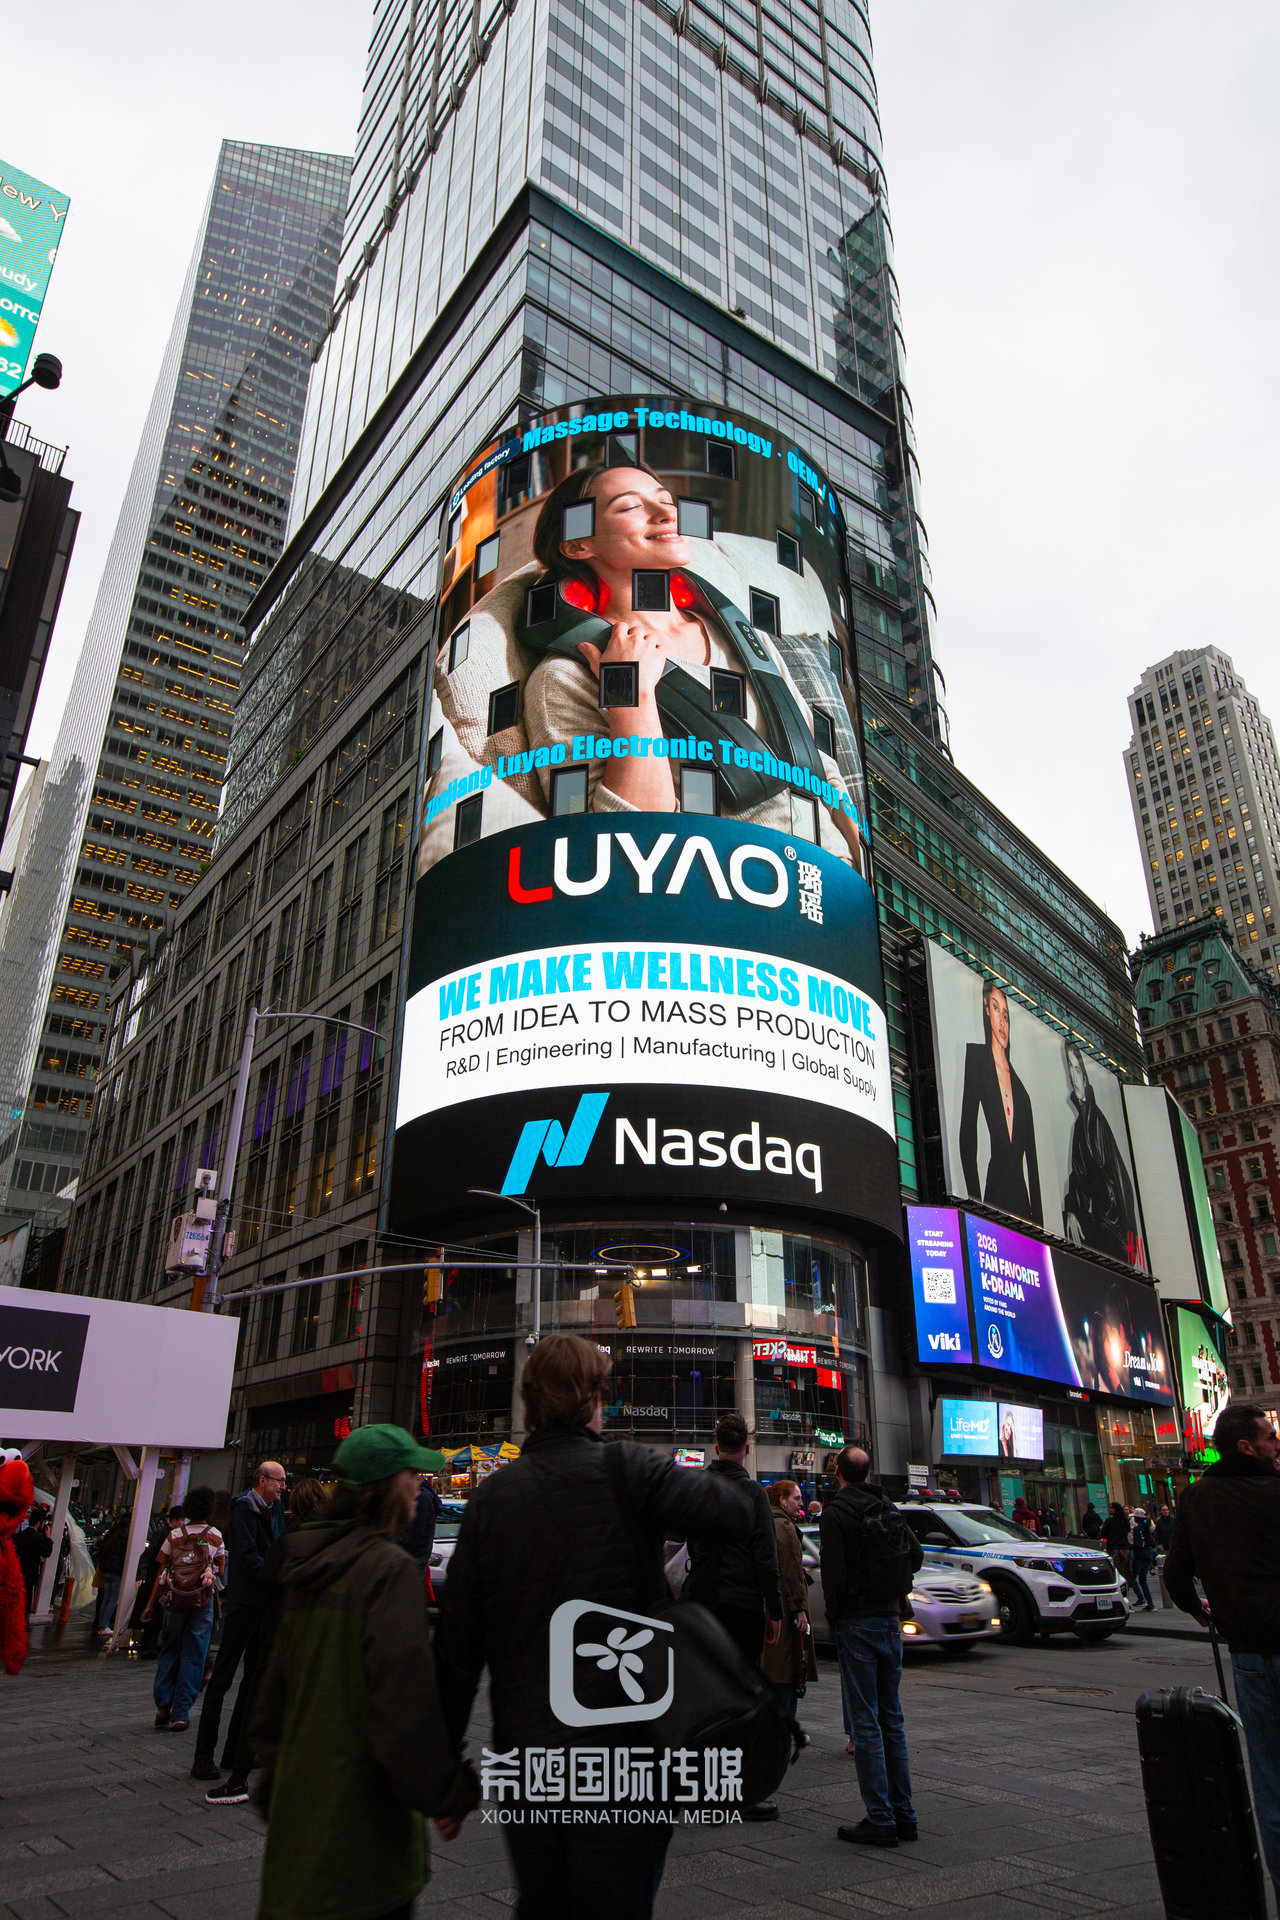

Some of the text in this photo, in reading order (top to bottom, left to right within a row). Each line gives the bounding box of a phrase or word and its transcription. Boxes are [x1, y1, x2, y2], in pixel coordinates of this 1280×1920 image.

[0, 264, 38, 291] udy
[484, 448, 511, 471] factory
[523, 411, 629, 453] Massage
[634, 407, 772, 459] Technology
[787, 450, 820, 494] OEM
[424, 764, 493, 826] Zhejiang
[497, 743, 566, 780] Luyao
[572, 735, 714, 762] Electronic
[718, 739, 841, 810] Technology
[797, 860, 824, 925] 璐瑶
[439, 951, 876, 1042] WE MAKE WELLNESS MOVE.
[440, 1000, 876, 1070] FROM IDEA TO MASS PRODUCTION
[446, 1054, 480, 1079] R&D
[496, 1038, 613, 1066] Engineering
[633, 1036, 776, 1069] Manufacturing
[792, 1052, 839, 1080] Global
[843, 1067, 877, 1101] Supply
[615, 1117, 823, 1194] Nasdaq
[916, 1240, 954, 1248] STREAMING
[925, 1249, 947, 1257] TODAY
[976, 1232, 998, 1253] 2026
[979, 1251, 1041, 1288] FAN FAVORITE
[981, 1271, 1026, 1302] K-DRAMA
[626, 1346, 664, 1354] REWRITE
[667, 1346, 716, 1355] TOMORROW
[928, 1332, 961, 1350] Viki
[1122, 1350, 1147, 1370] Dream
[623, 1405, 668, 1419] Nasdaq
[950, 1416, 991, 1433] LifeMD
[982, 1552, 1005, 1560] POLICE
